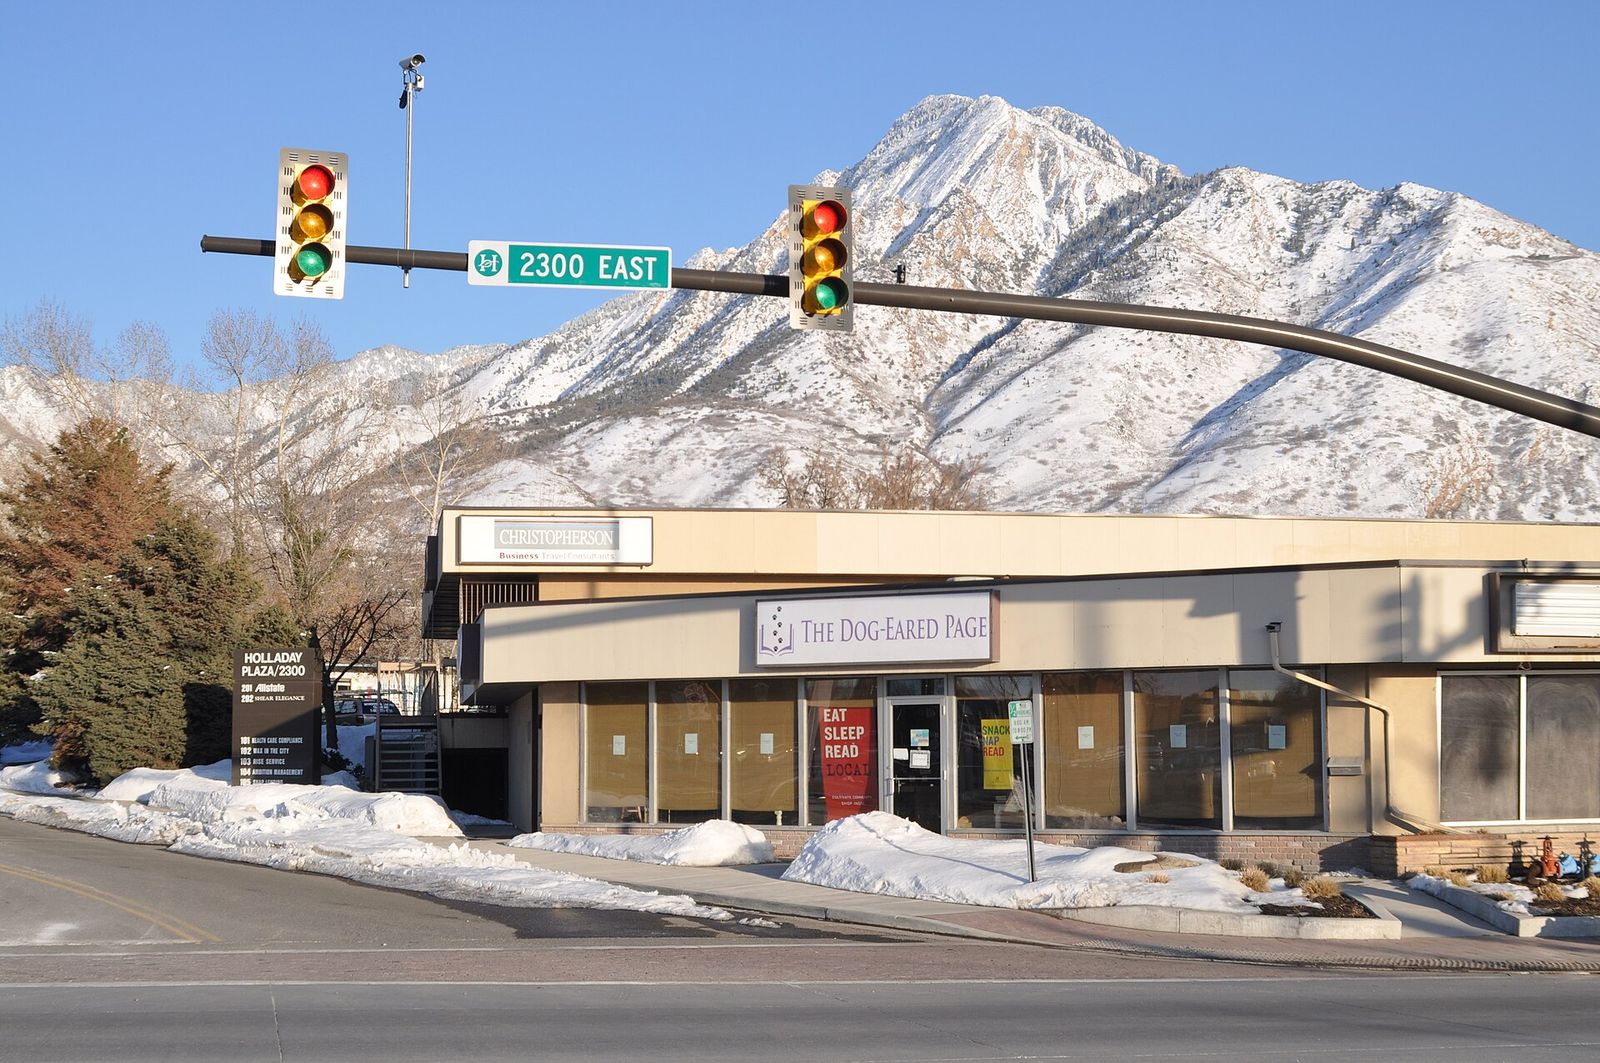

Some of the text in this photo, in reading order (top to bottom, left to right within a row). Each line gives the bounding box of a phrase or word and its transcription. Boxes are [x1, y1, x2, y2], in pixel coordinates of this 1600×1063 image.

[520, 252, 657, 280] 2300 EAST
[499, 529, 614, 545] CHRISTOPHERSON
[499, 552, 616, 560] Business Travel Consultants
[801, 614, 987, 643] THE DOG-EARED PAGE
[244, 652, 303, 664] HOLLADAY
[241, 665, 306, 677] PLAZA/2300
[241, 683, 285, 693] 201 Allstate
[241, 695, 254, 703] 202
[823, 708, 847, 722] EAT
[824, 726, 865, 741] SLEEP
[982, 725, 1010, 735] SNACK
[240, 736, 250, 745] 101
[240, 747, 252, 755] 102
[825, 744, 859, 759] READ
[983, 747, 1005, 757] READ
[240, 757, 251, 766] 103
[240, 767, 251, 776] 104
[826, 763, 870, 777] LOCAL
